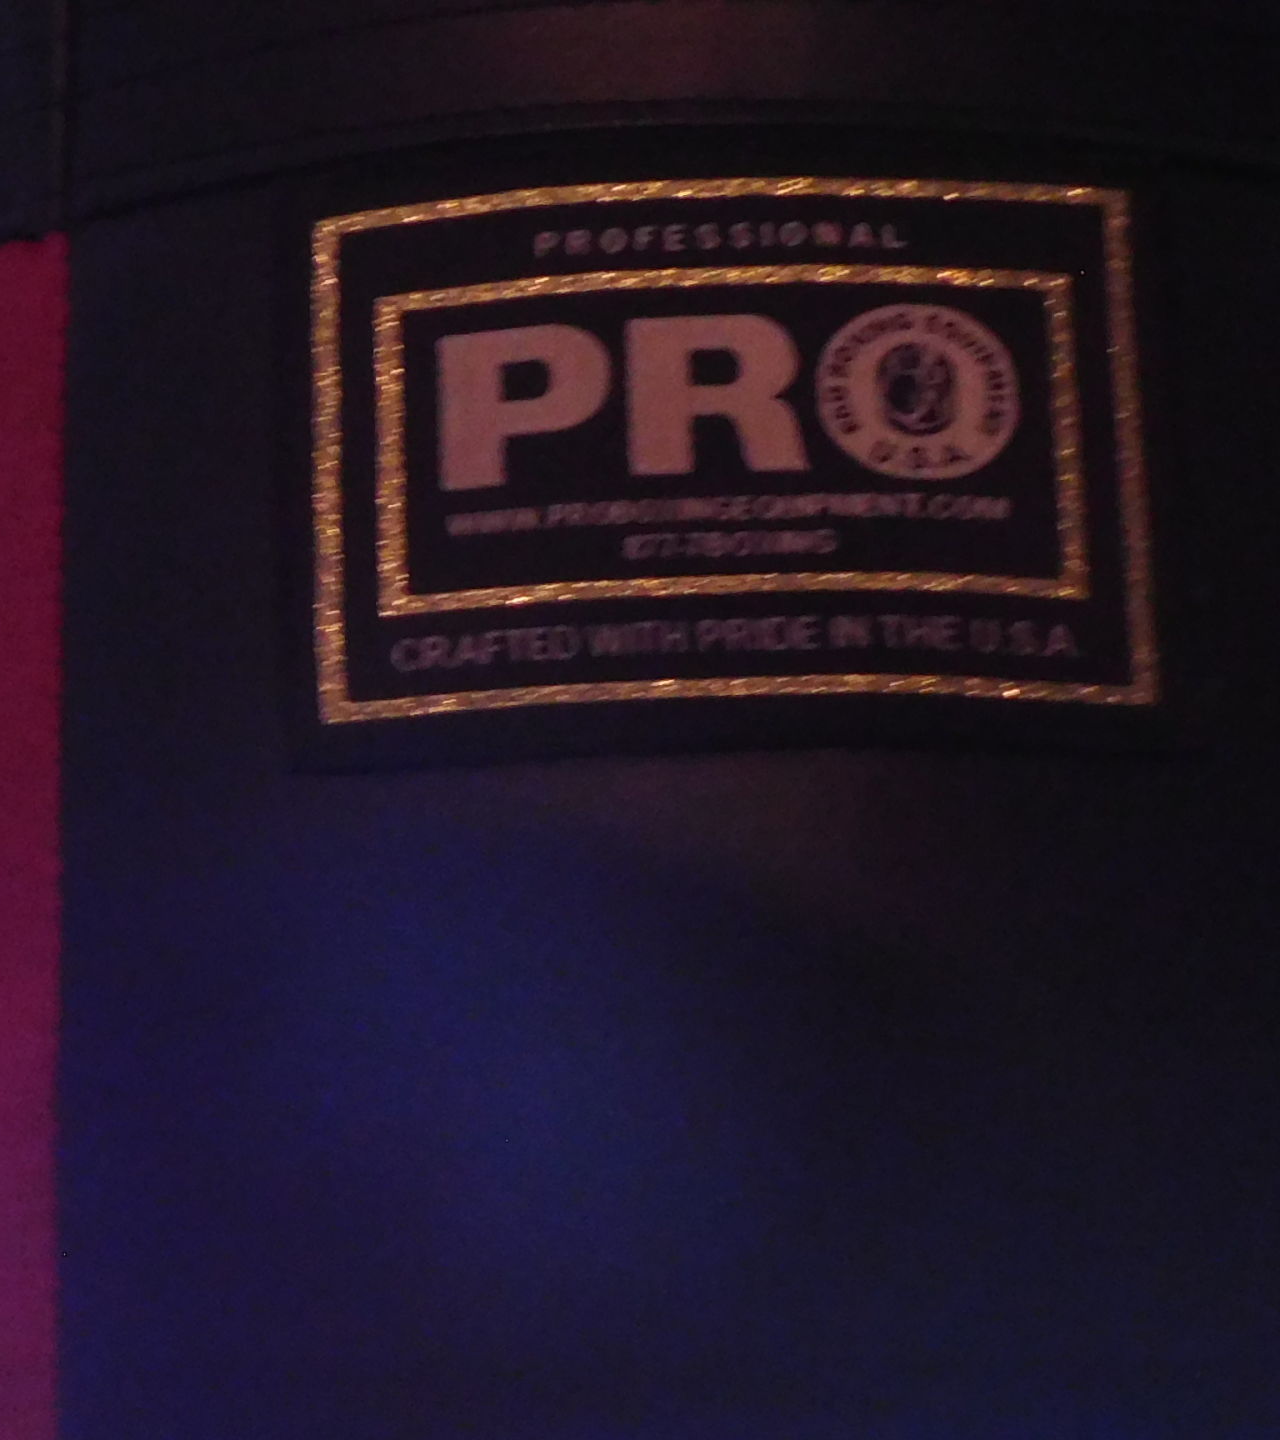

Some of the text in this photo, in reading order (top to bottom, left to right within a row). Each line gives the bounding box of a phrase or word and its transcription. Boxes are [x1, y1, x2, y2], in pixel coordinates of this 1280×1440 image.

[532, 220, 909, 258] PROFESSIONAL
[435, 302, 1021, 490] PRO
[390, 624, 582, 673] CRAFTED
[587, 619, 690, 657] WITH
[696, 614, 820, 655] PRIDE
[826, 613, 875, 649] IN
[877, 613, 966, 651] THE
